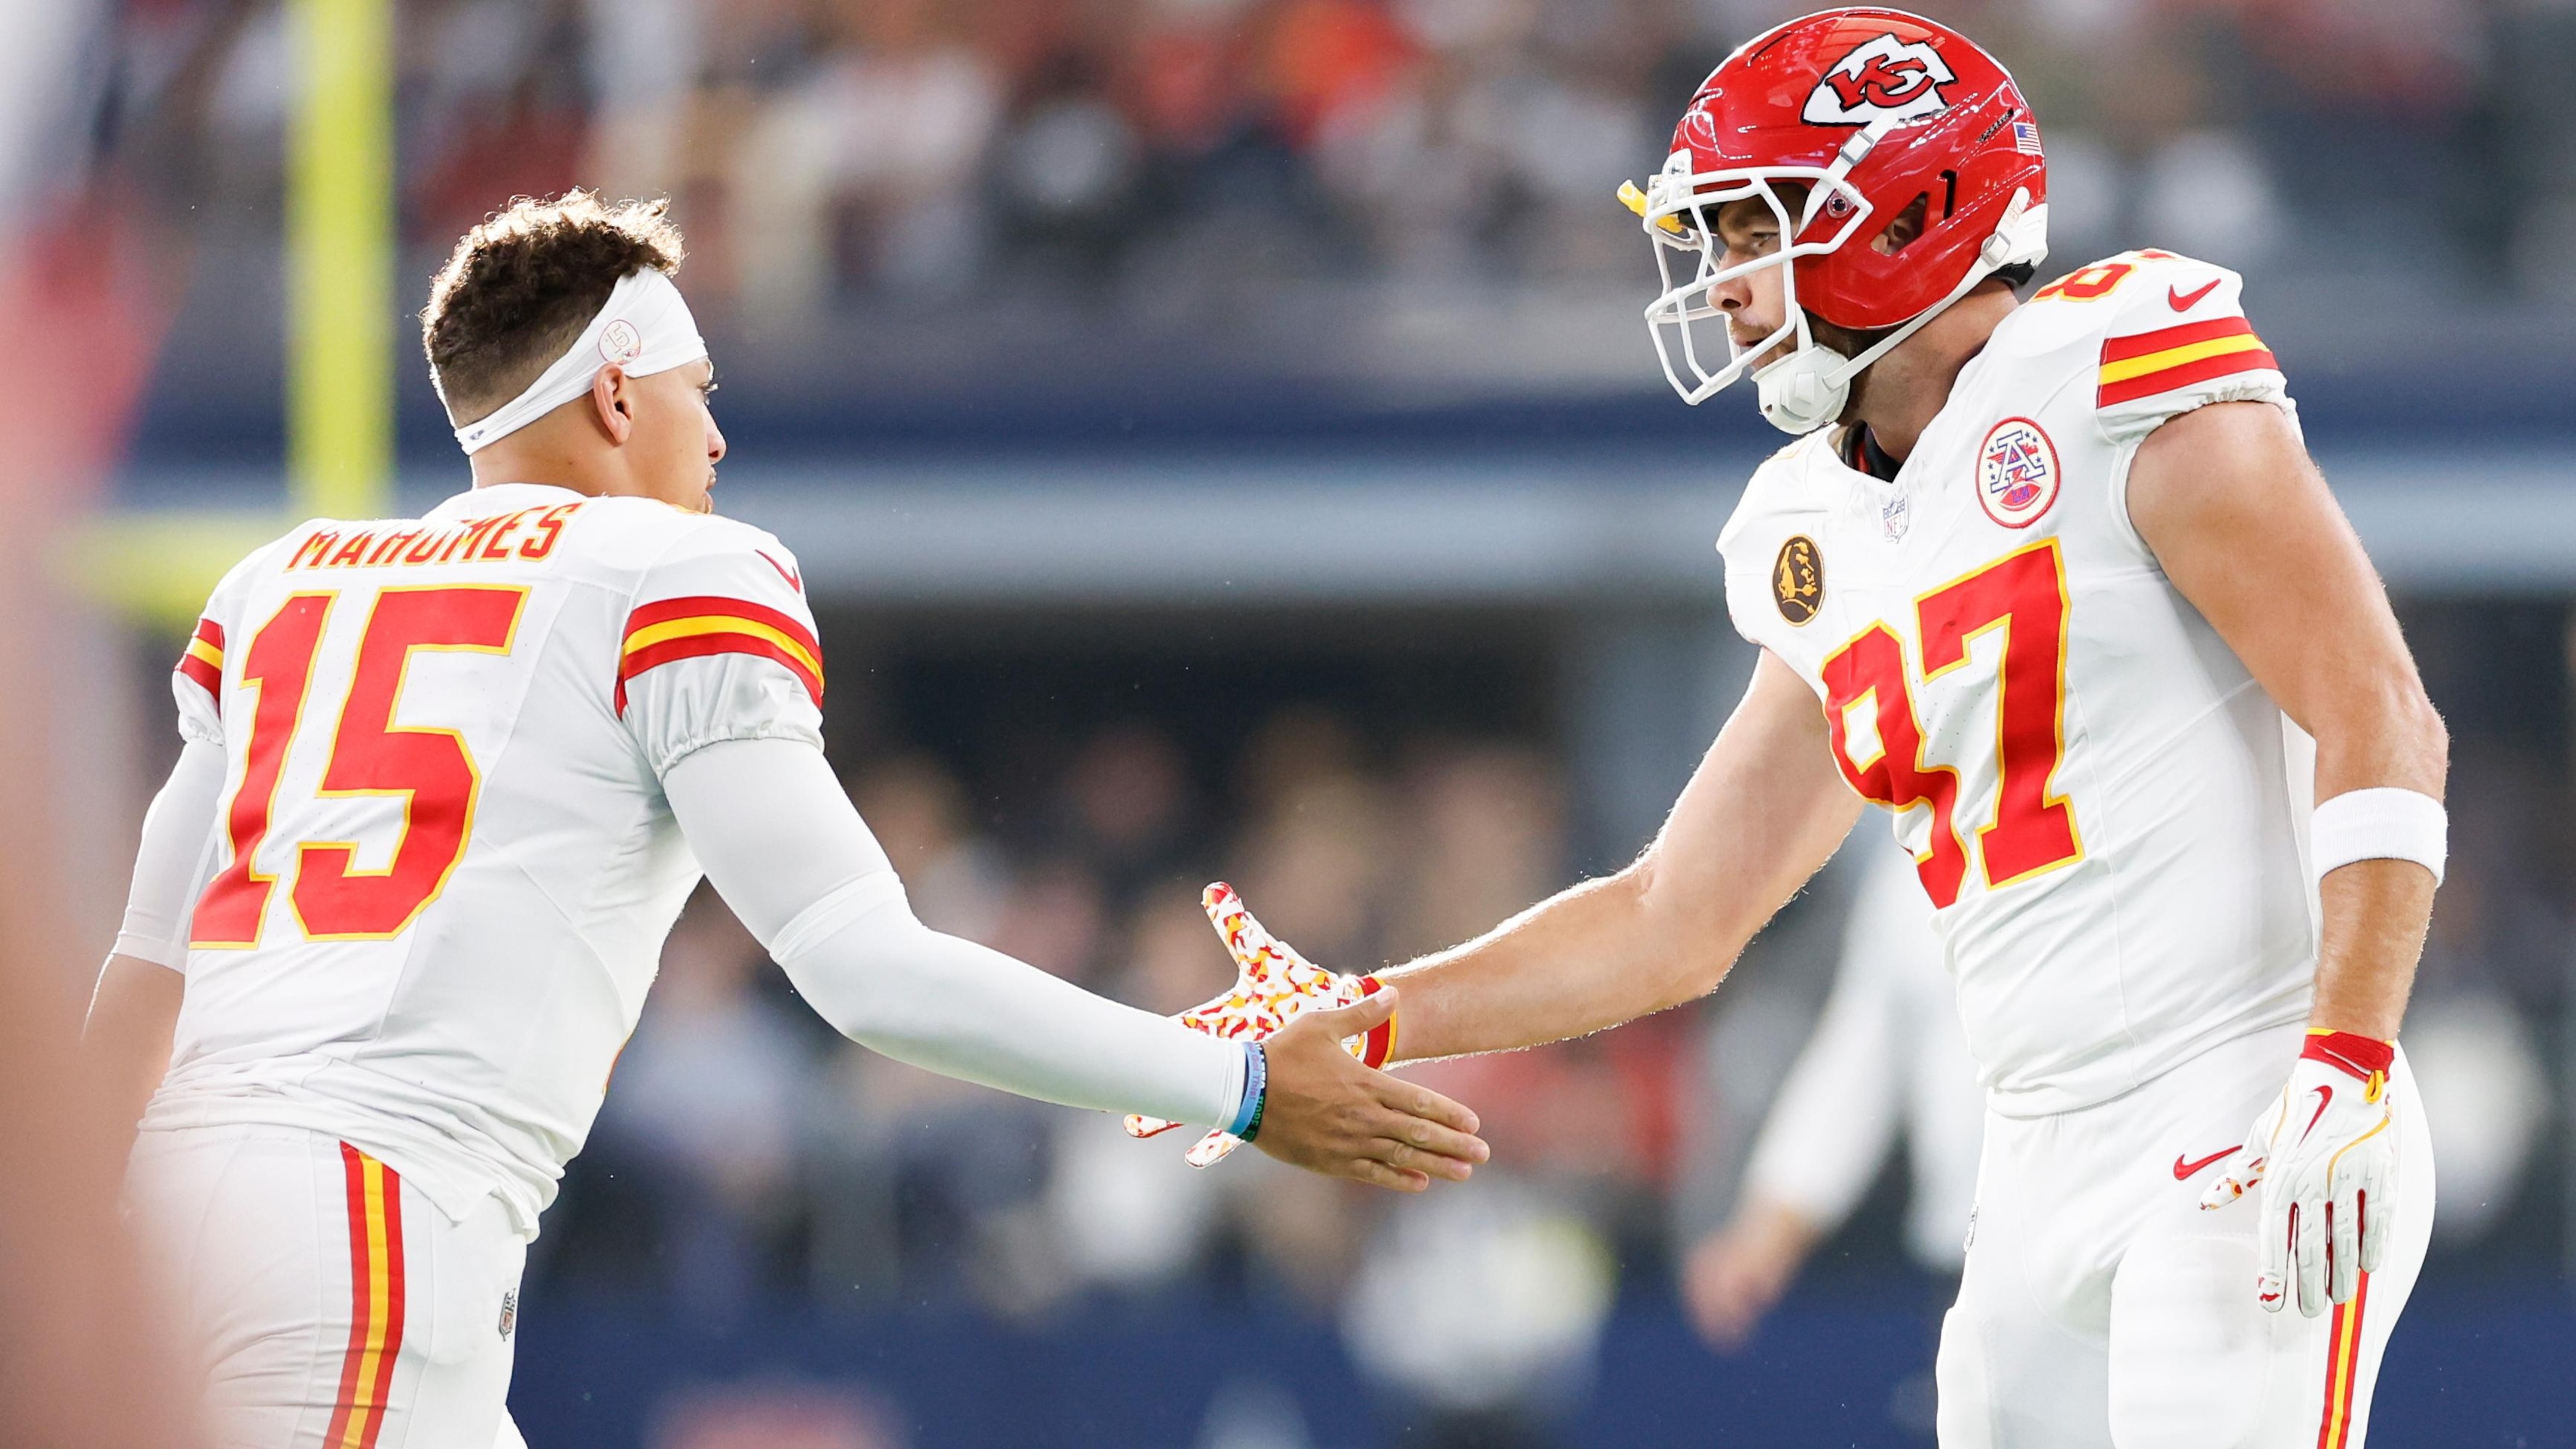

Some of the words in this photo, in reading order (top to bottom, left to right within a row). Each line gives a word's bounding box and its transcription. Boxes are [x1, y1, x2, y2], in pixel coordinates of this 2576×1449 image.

[1825, 53, 1935, 112] KC
[1990, 429, 2046, 493] A
[283, 501, 587, 573] MAHOMES
[1886, 513, 1904, 535] NFL
[188, 585, 532, 951] 15
